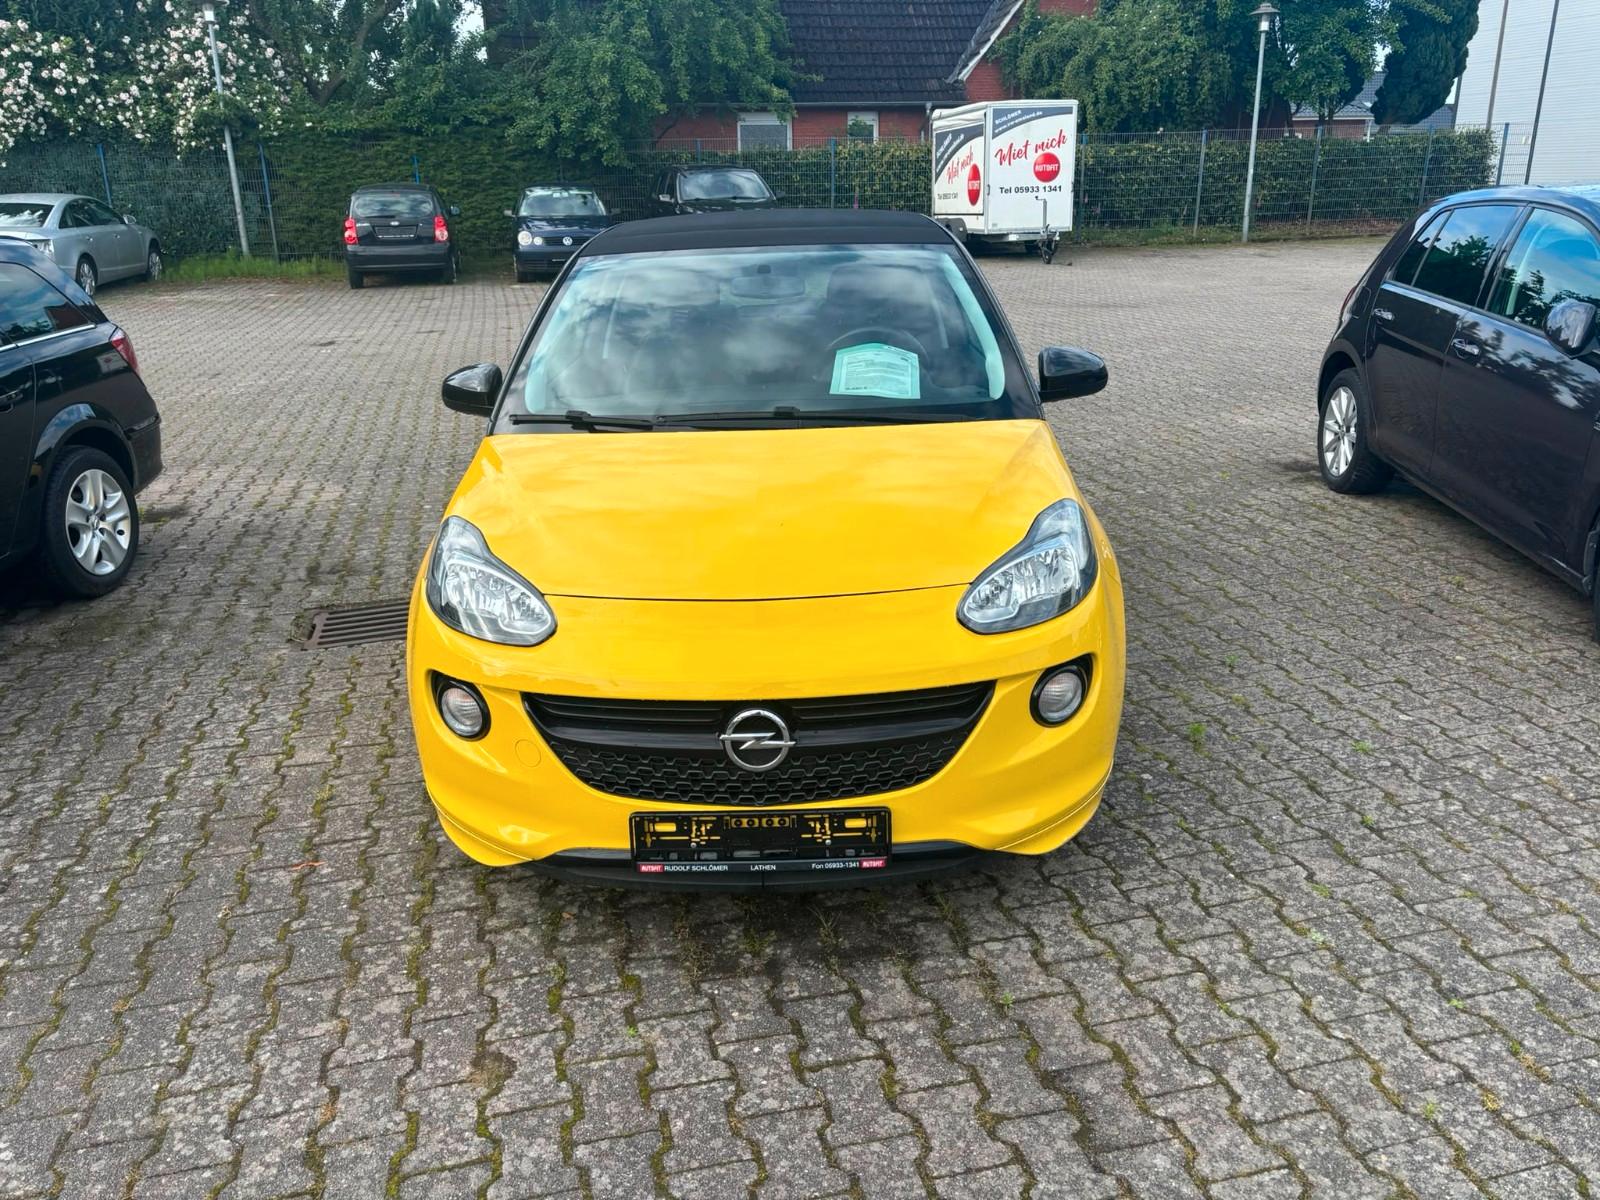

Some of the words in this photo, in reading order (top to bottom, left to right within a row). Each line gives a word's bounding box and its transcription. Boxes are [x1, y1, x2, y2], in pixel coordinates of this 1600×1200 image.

[994, 139, 1031, 166] Miet
[1034, 128, 1067, 154] mich
[1035, 163, 1059, 172] AUTOFIT
[1014, 186, 1040, 194] 05933
[691, 864, 728, 872] SCHLÖMER
